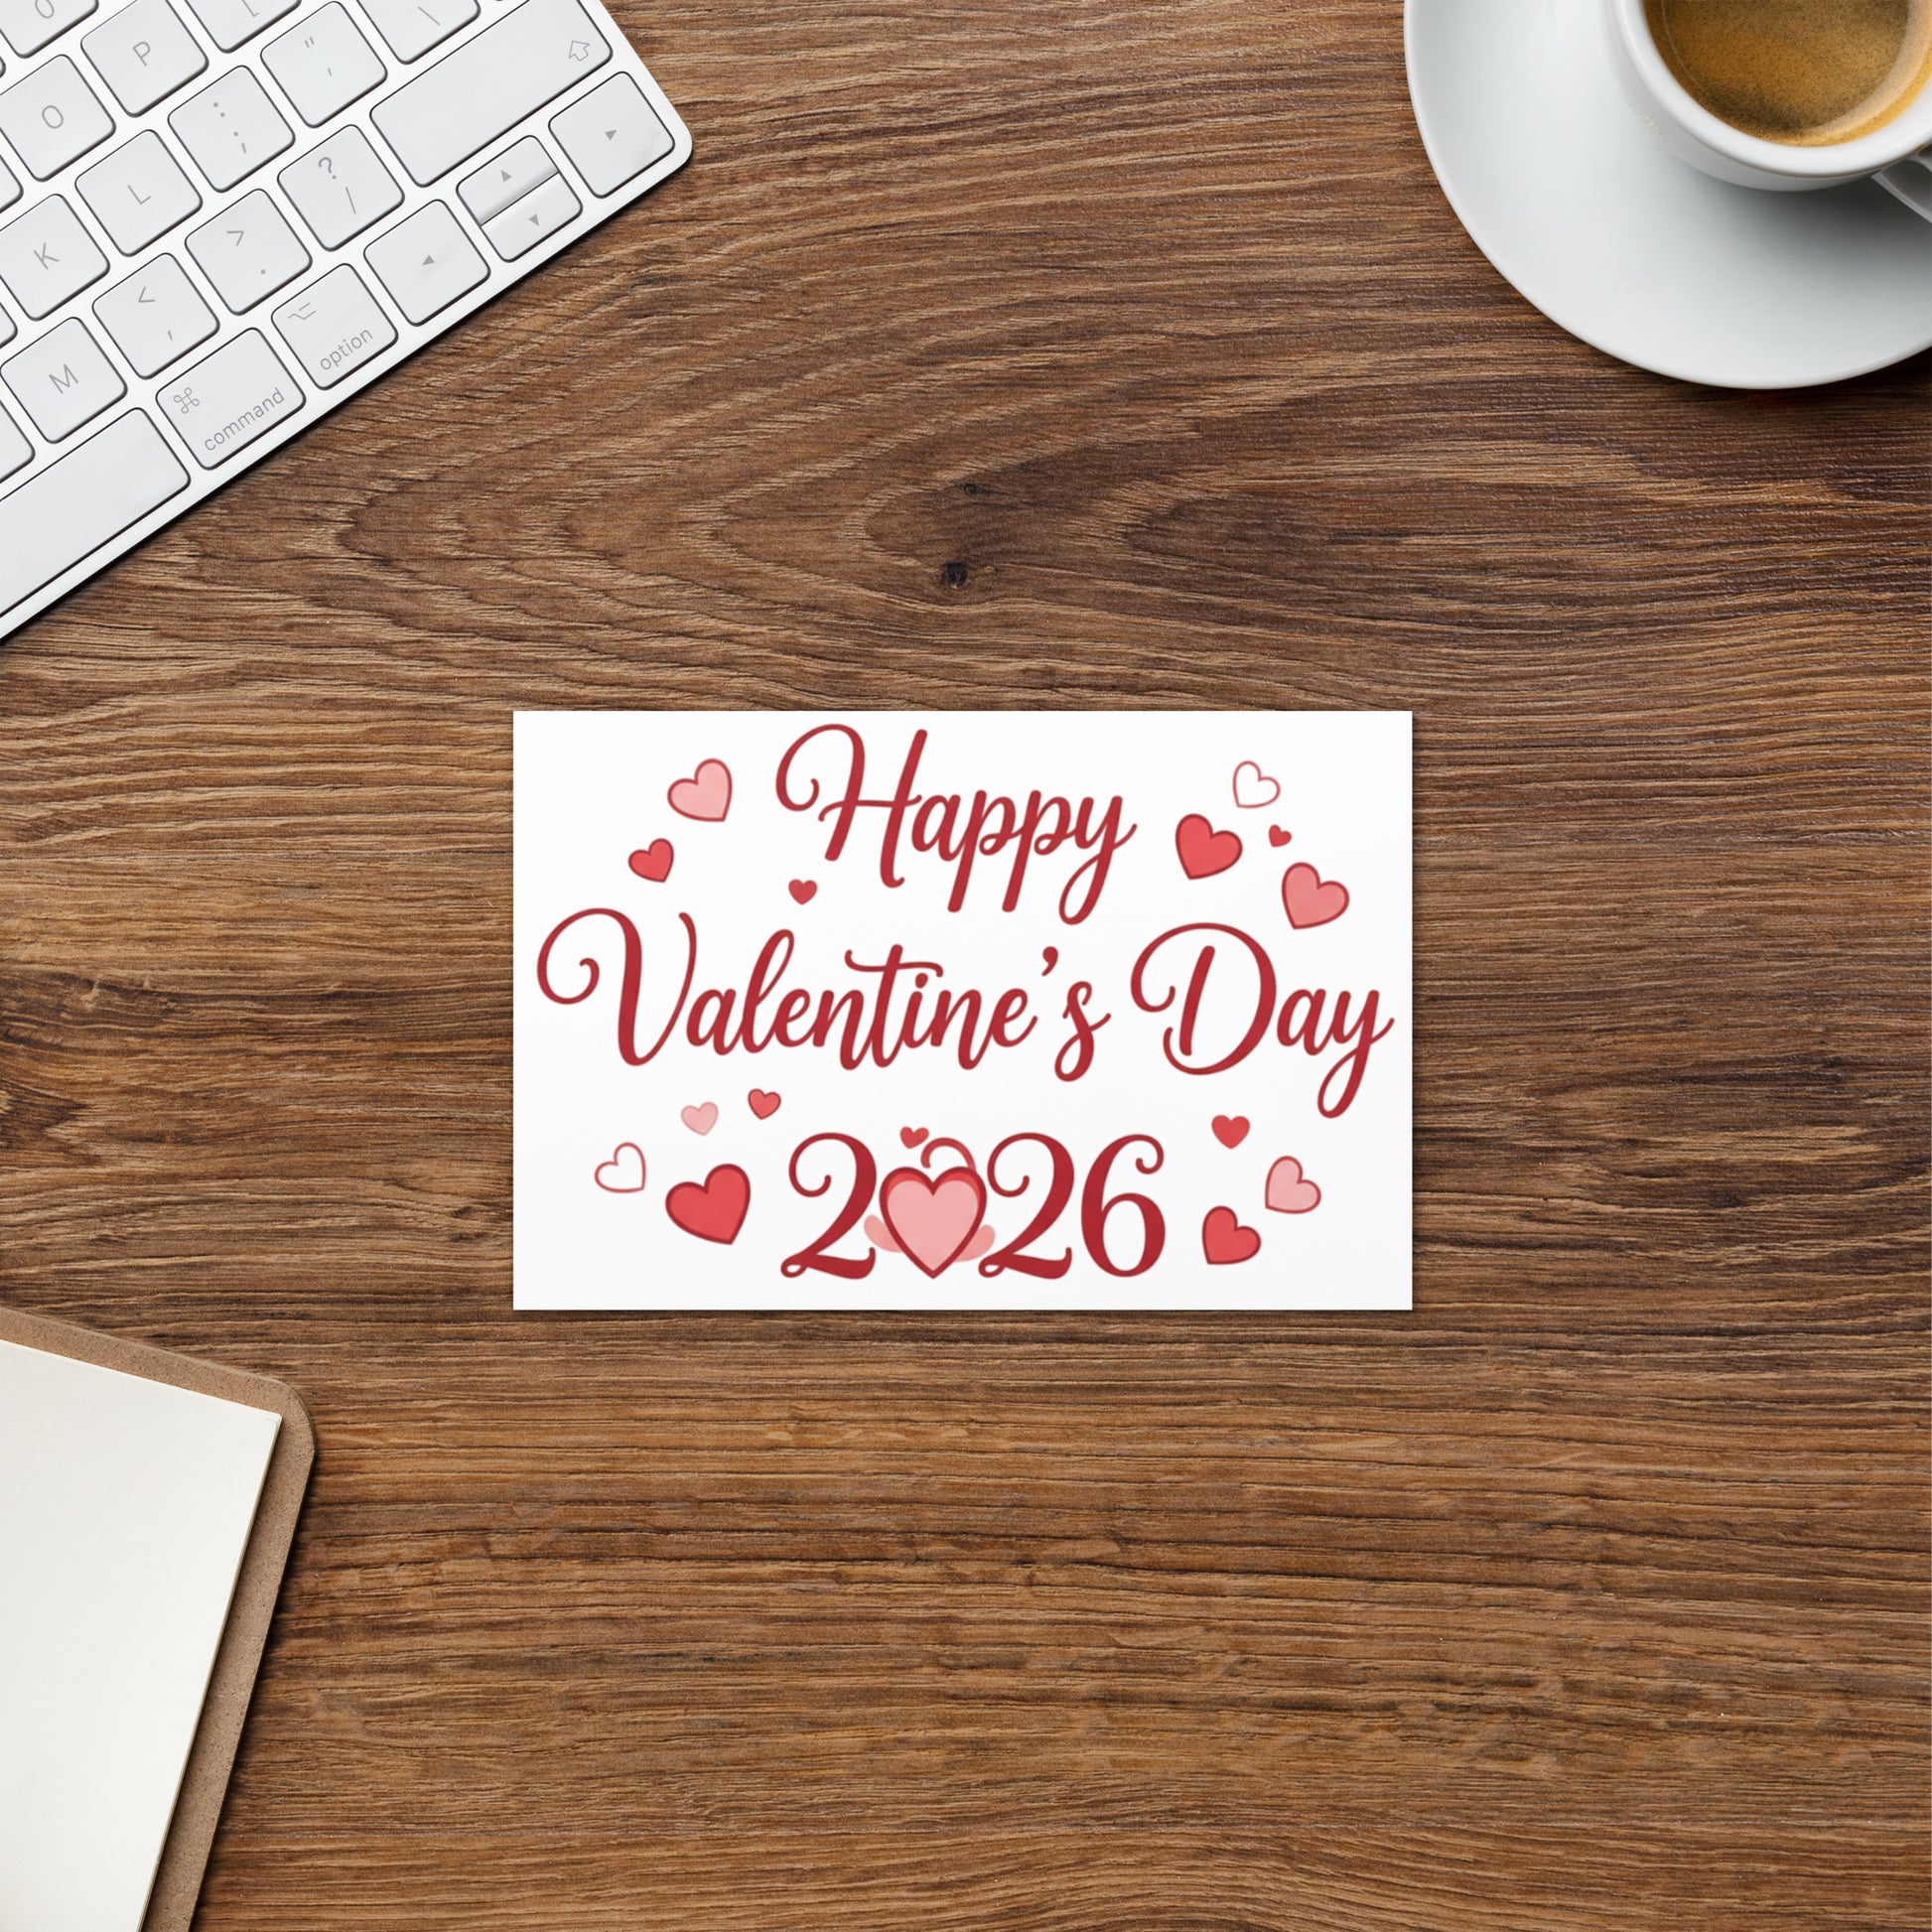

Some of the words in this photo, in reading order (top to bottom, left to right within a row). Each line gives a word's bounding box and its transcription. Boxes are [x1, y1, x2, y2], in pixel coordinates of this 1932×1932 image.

[132, 41, 152, 68] P
[42, 105, 65, 129] O
[318, 156, 338, 181] ?
[127, 184, 152, 206] L
[33, 241, 60, 271] K
[320, 329, 373, 371] option
[49, 362, 79, 395] M
[204, 387, 286, 452] command
[775, 724, 1138, 925] Happy
[536, 907, 1112, 1082] Valentine’s
[1130, 922, 1395, 1119] Day
